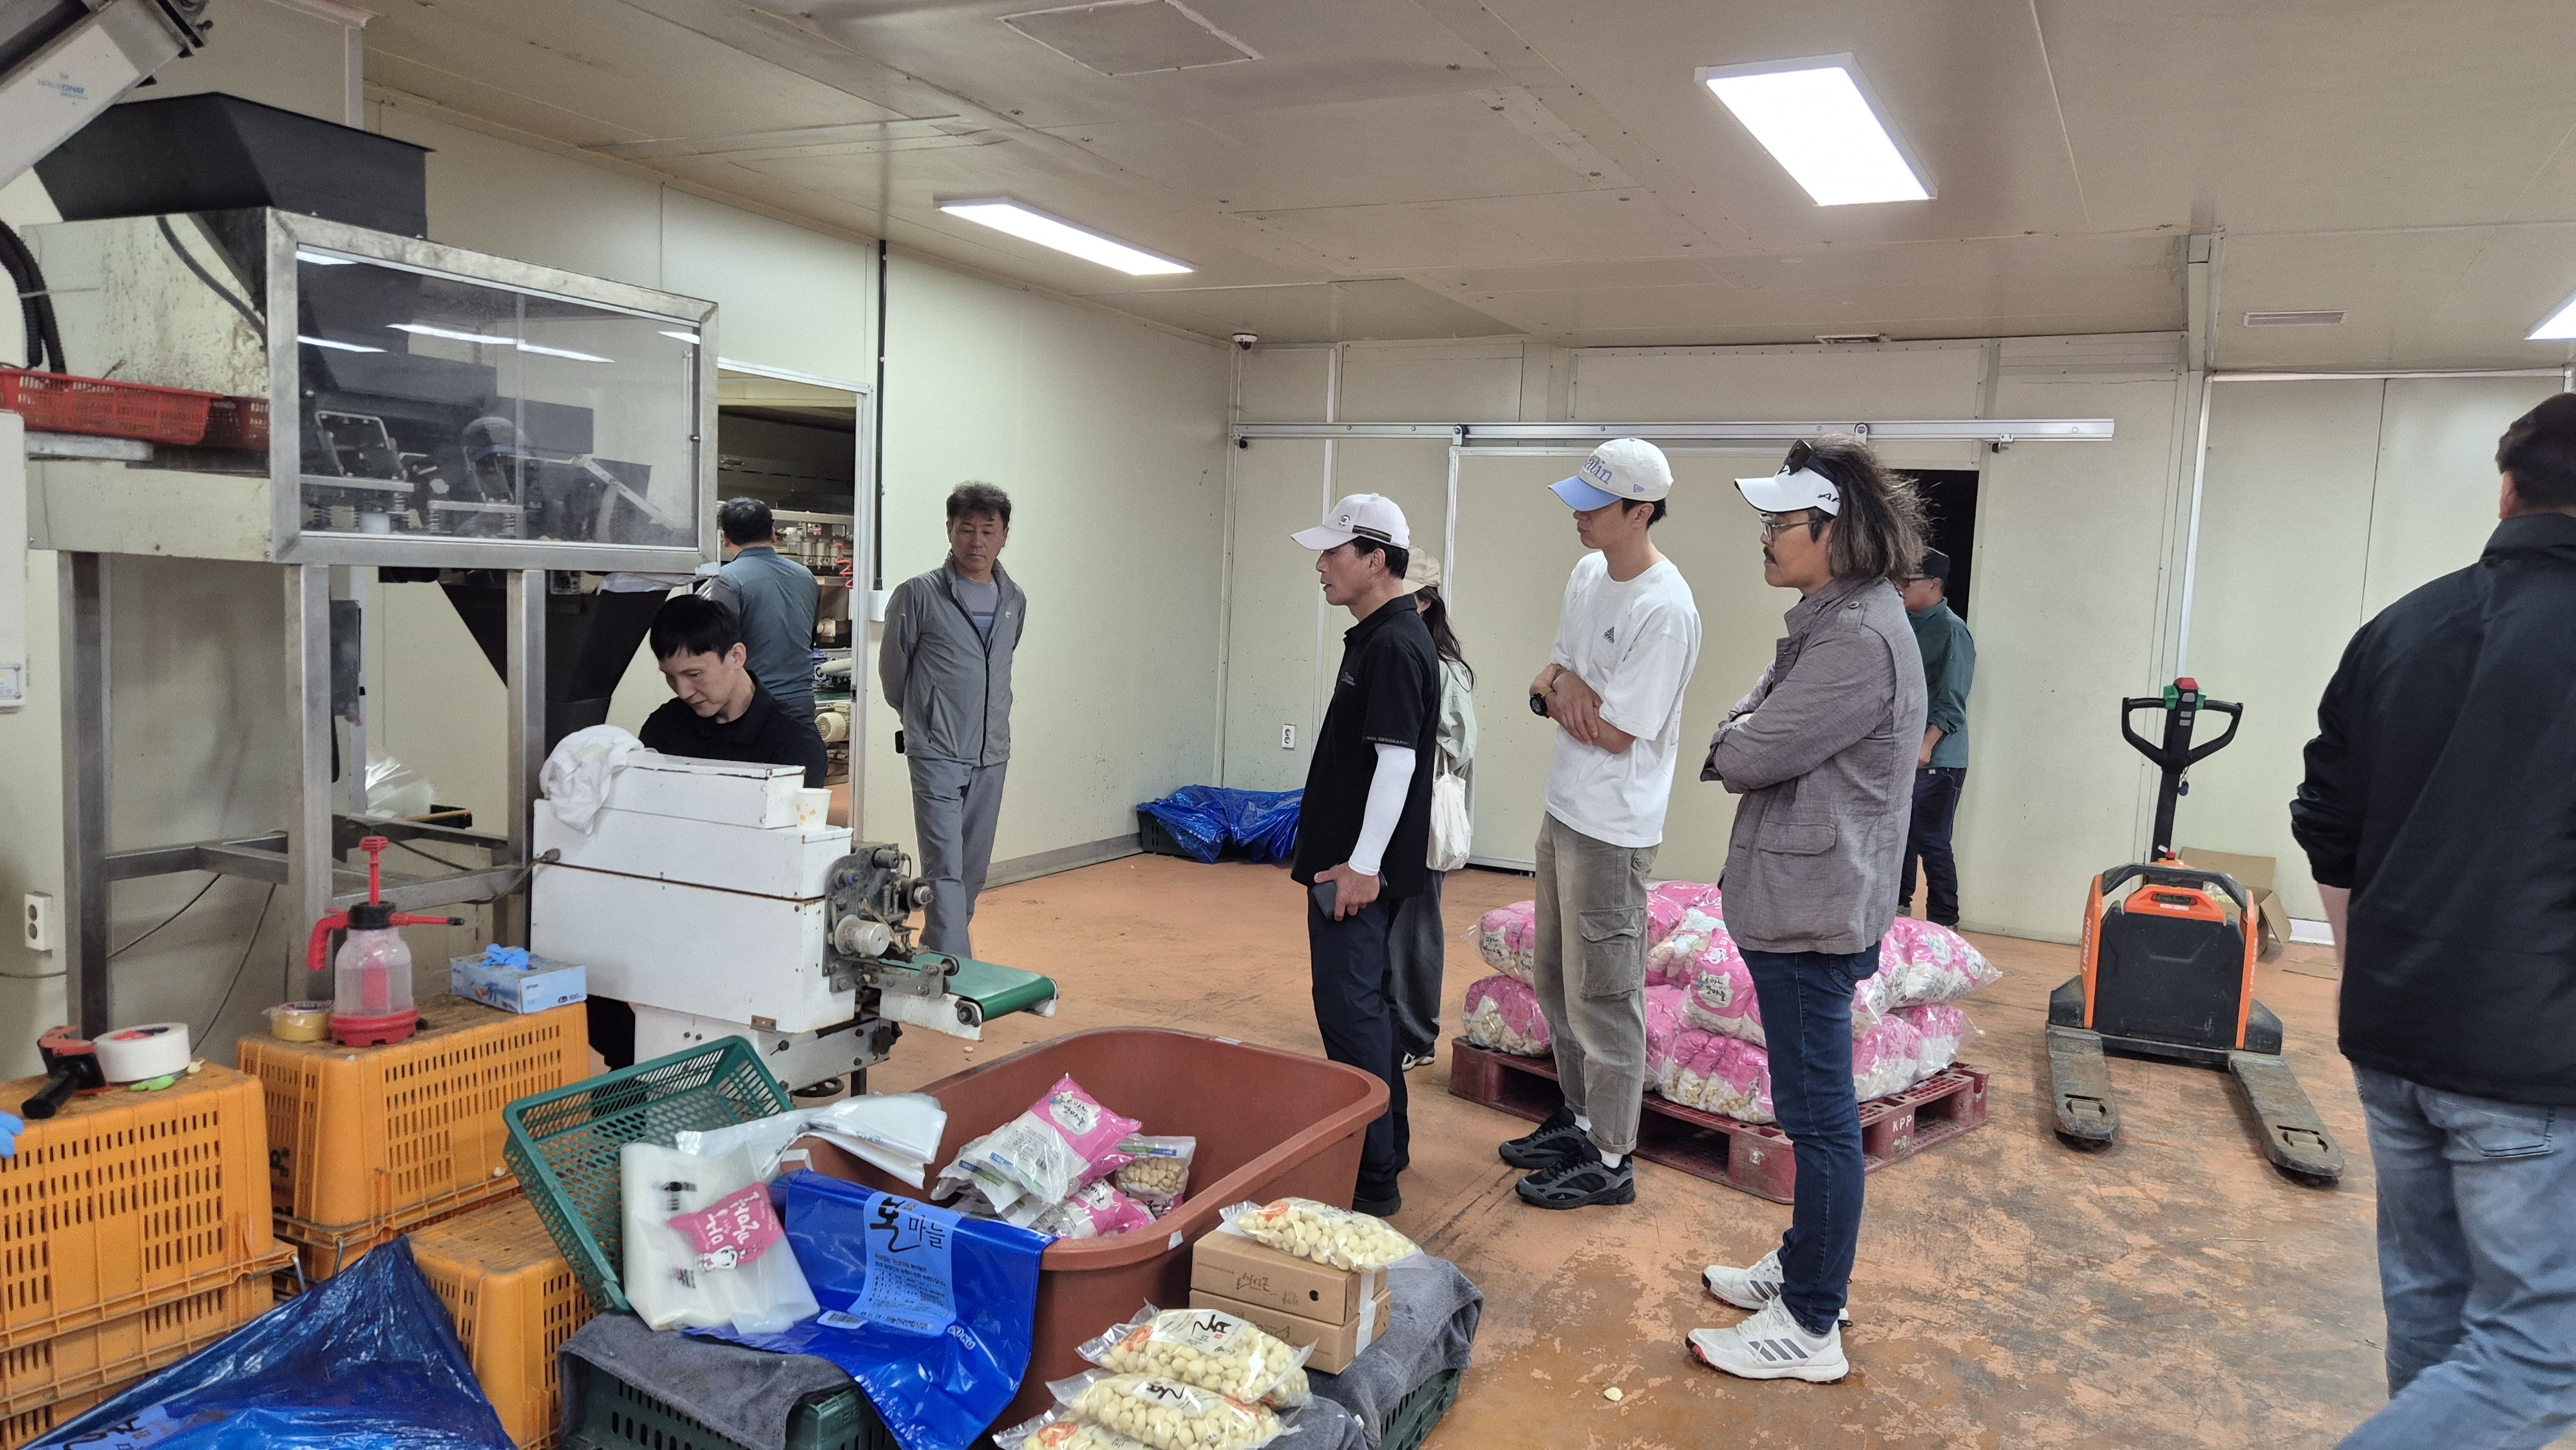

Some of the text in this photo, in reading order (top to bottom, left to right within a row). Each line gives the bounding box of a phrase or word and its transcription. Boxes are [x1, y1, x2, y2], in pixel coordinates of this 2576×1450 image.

[2082, 916, 2092, 973] LPM20N
[1892, 1114, 1912, 1133] KPP
[909, 1214, 946, 1250] 마늘
